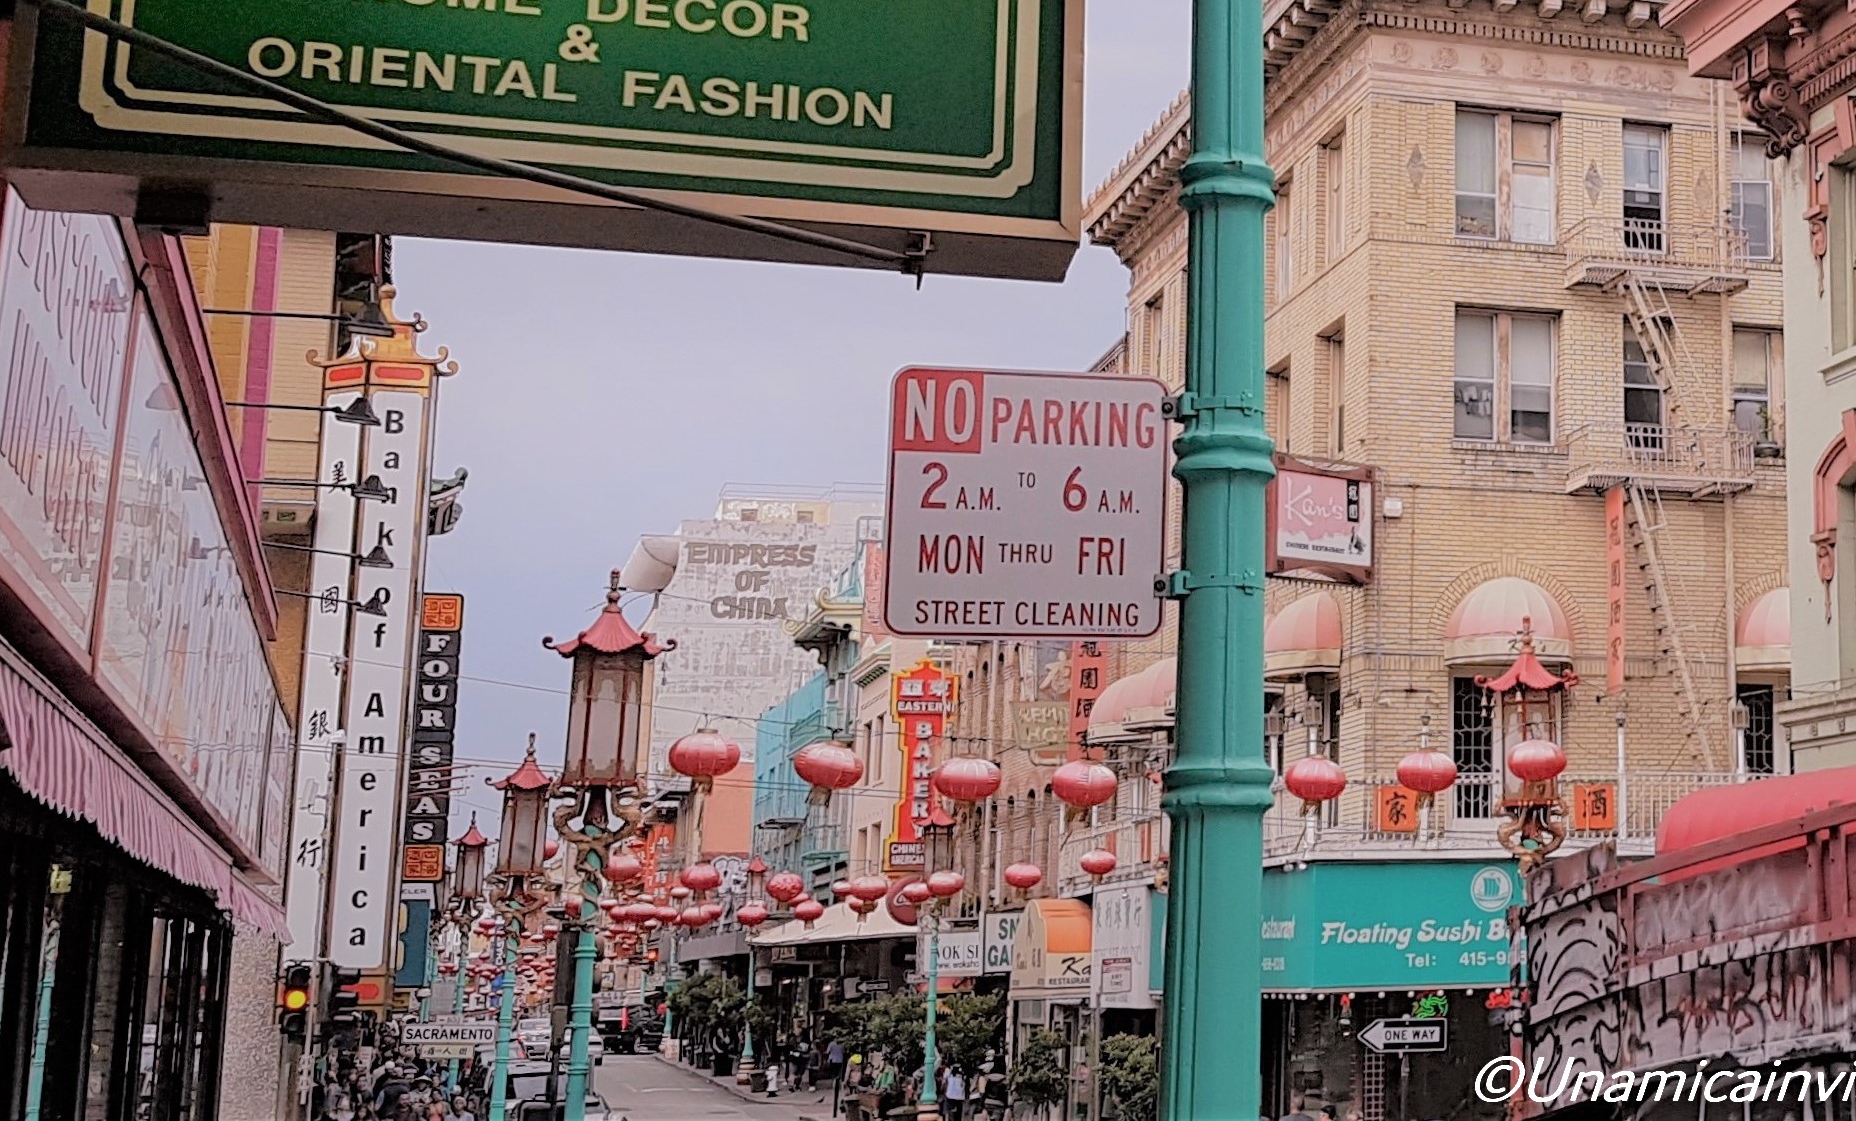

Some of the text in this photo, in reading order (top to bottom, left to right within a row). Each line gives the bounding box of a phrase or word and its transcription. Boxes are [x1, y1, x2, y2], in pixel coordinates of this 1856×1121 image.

[558, 23, 600, 63] &
[246, 36, 894, 129] ORIENTAL FASHION
[904, 377, 1156, 449] NO PARKING
[920, 461, 1141, 514] 2 A.M. TO 6 A.M.
[1284, 476, 1345, 527] Kan's
[684, 541, 818, 568] EMPRESS
[917, 534, 1126, 576] MON THRU FRI
[734, 570, 771, 592] OF
[709, 595, 789, 621] CHINA
[914, 600, 1140, 628] STREET CLEANING
[897, 700, 951, 713] EASTERN
[411, 633, 451, 841] FOUR SEAS
[348, 692, 386, 947] America
[1320, 921, 1412, 949] Floating
[1416, 918, 1482, 945] Sushi
[935, 943, 962, 961] OK
[1405, 952, 1437, 968] Tel:
[405, 1028, 493, 1041] SACRAMENTO
[1384, 1029, 1436, 1041] ONE WAY
